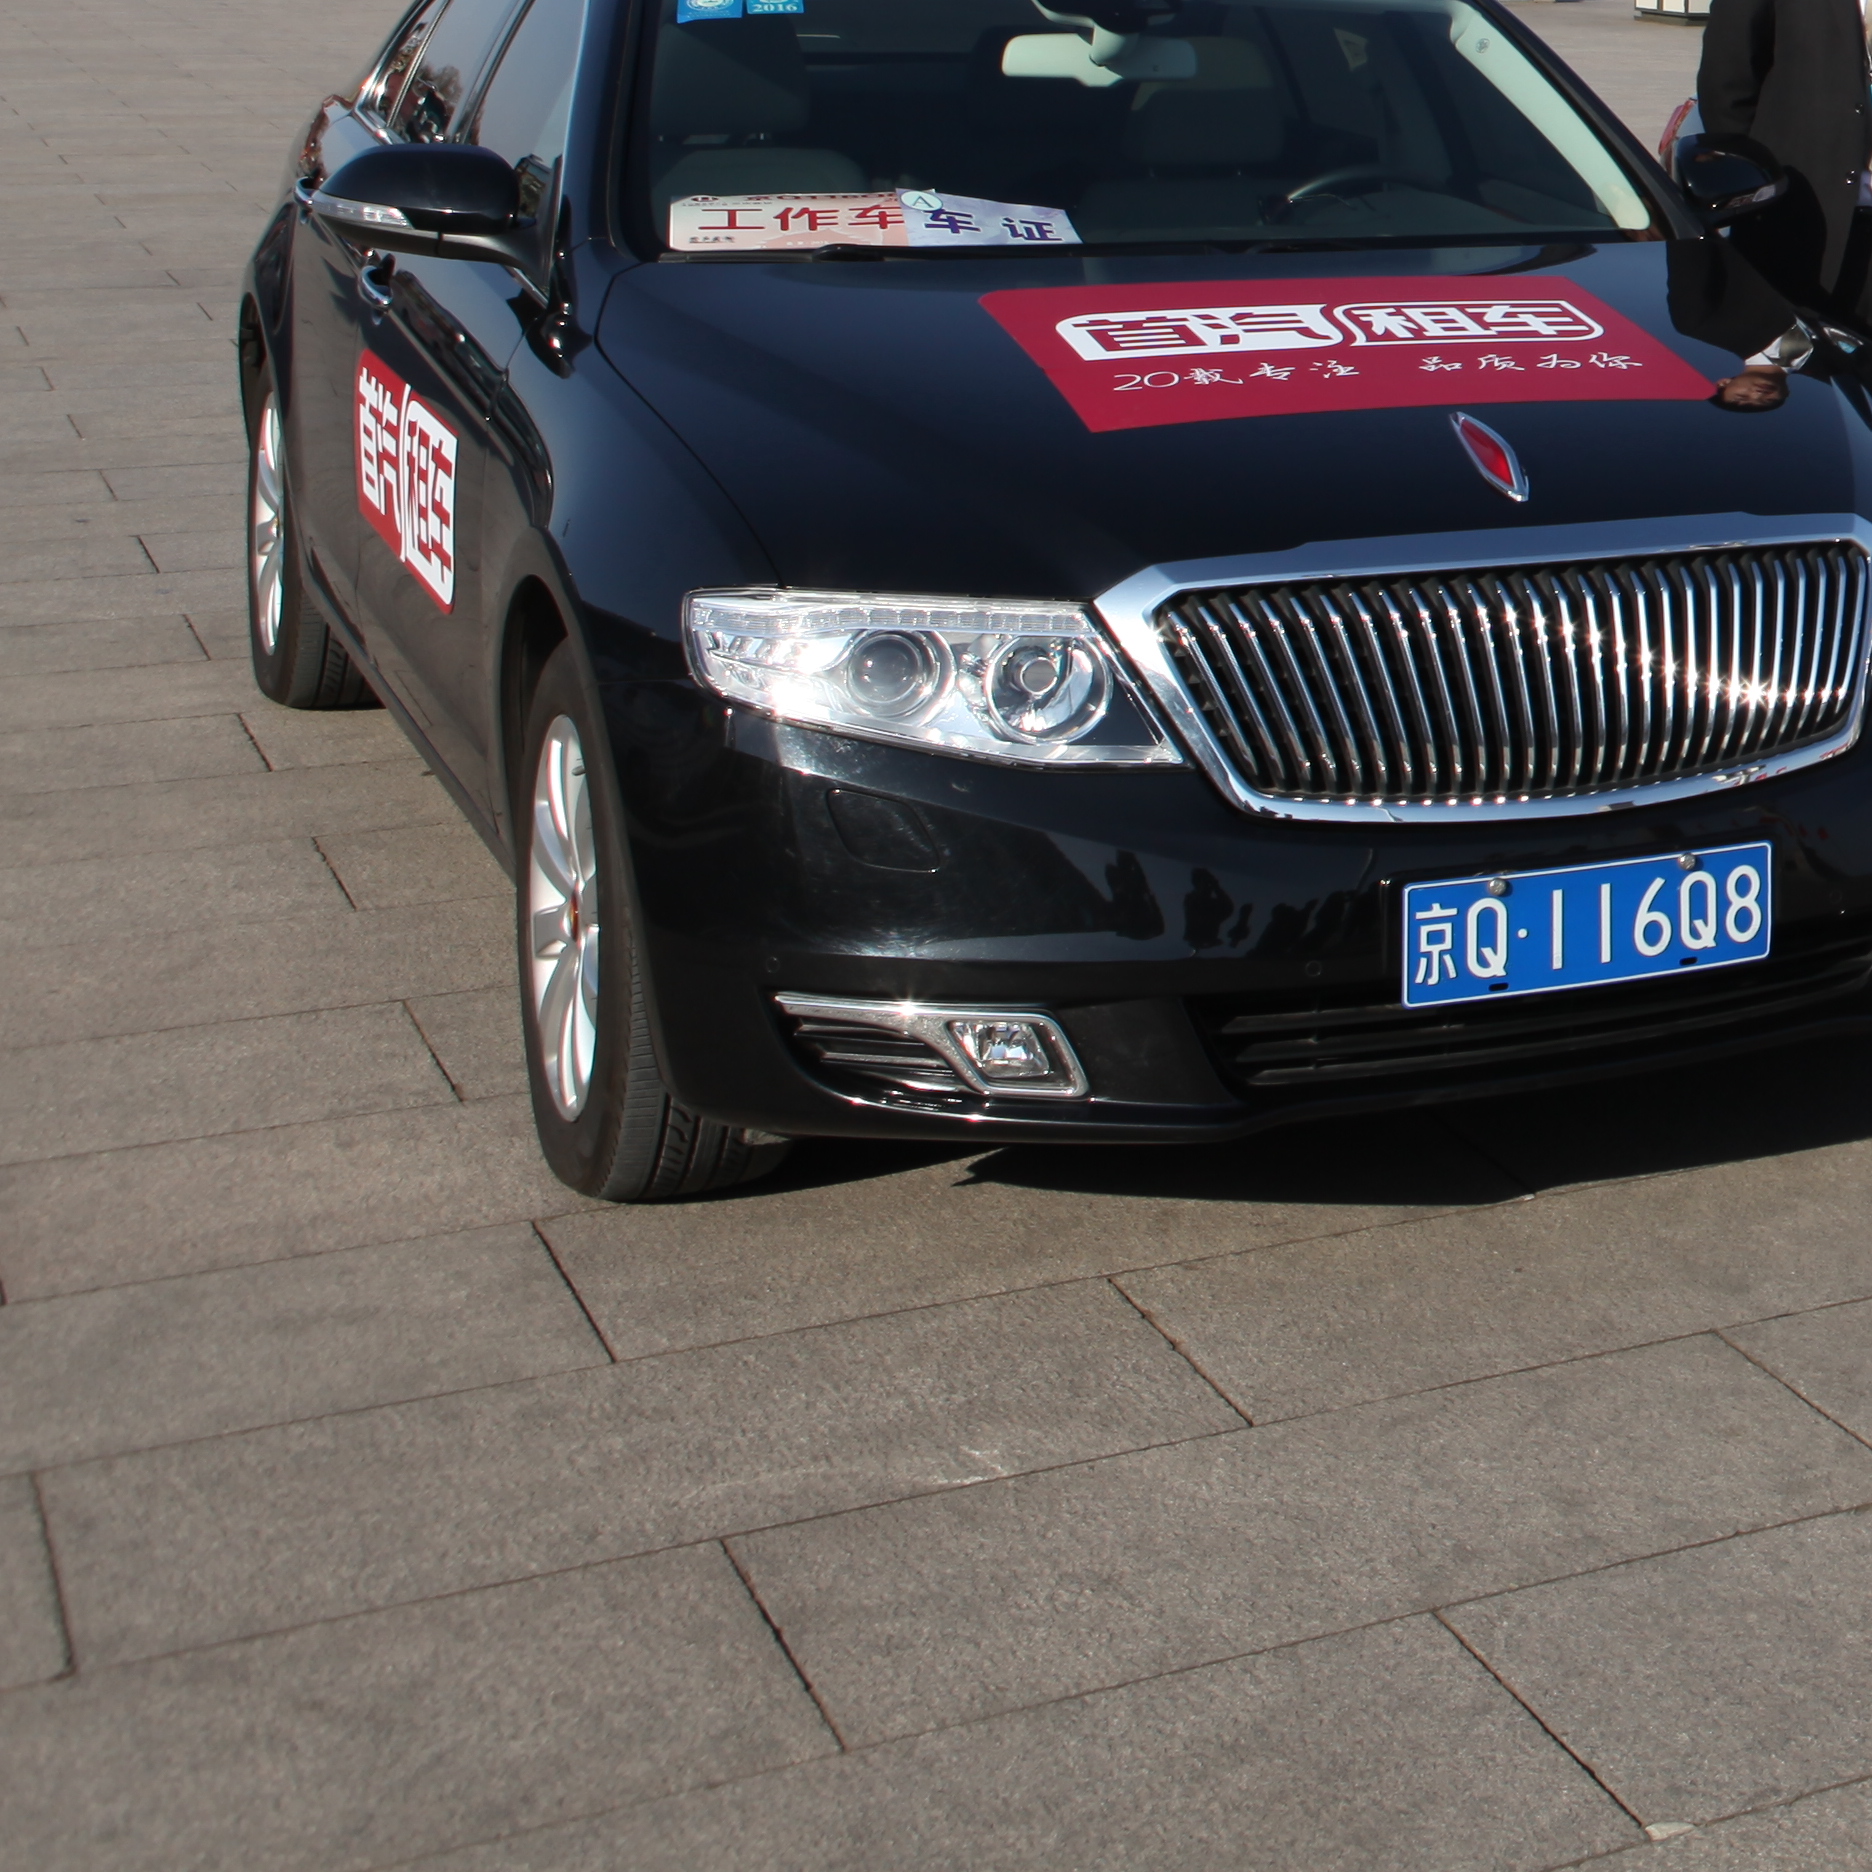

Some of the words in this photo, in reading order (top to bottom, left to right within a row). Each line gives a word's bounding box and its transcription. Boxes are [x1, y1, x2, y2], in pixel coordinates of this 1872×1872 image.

[752, 3, 798, 13] 2016
[698, 204, 905, 231] 工作车
[912, 195, 934, 209] A
[923, 208, 1063, 241] 车证
[1056, 299, 1604, 361] 首汽租车
[1113, 358, 1360, 392] 20载专注
[1418, 351, 1644, 374] 品质为你
[1415, 864, 1762, 986] 京Q·116Q8
